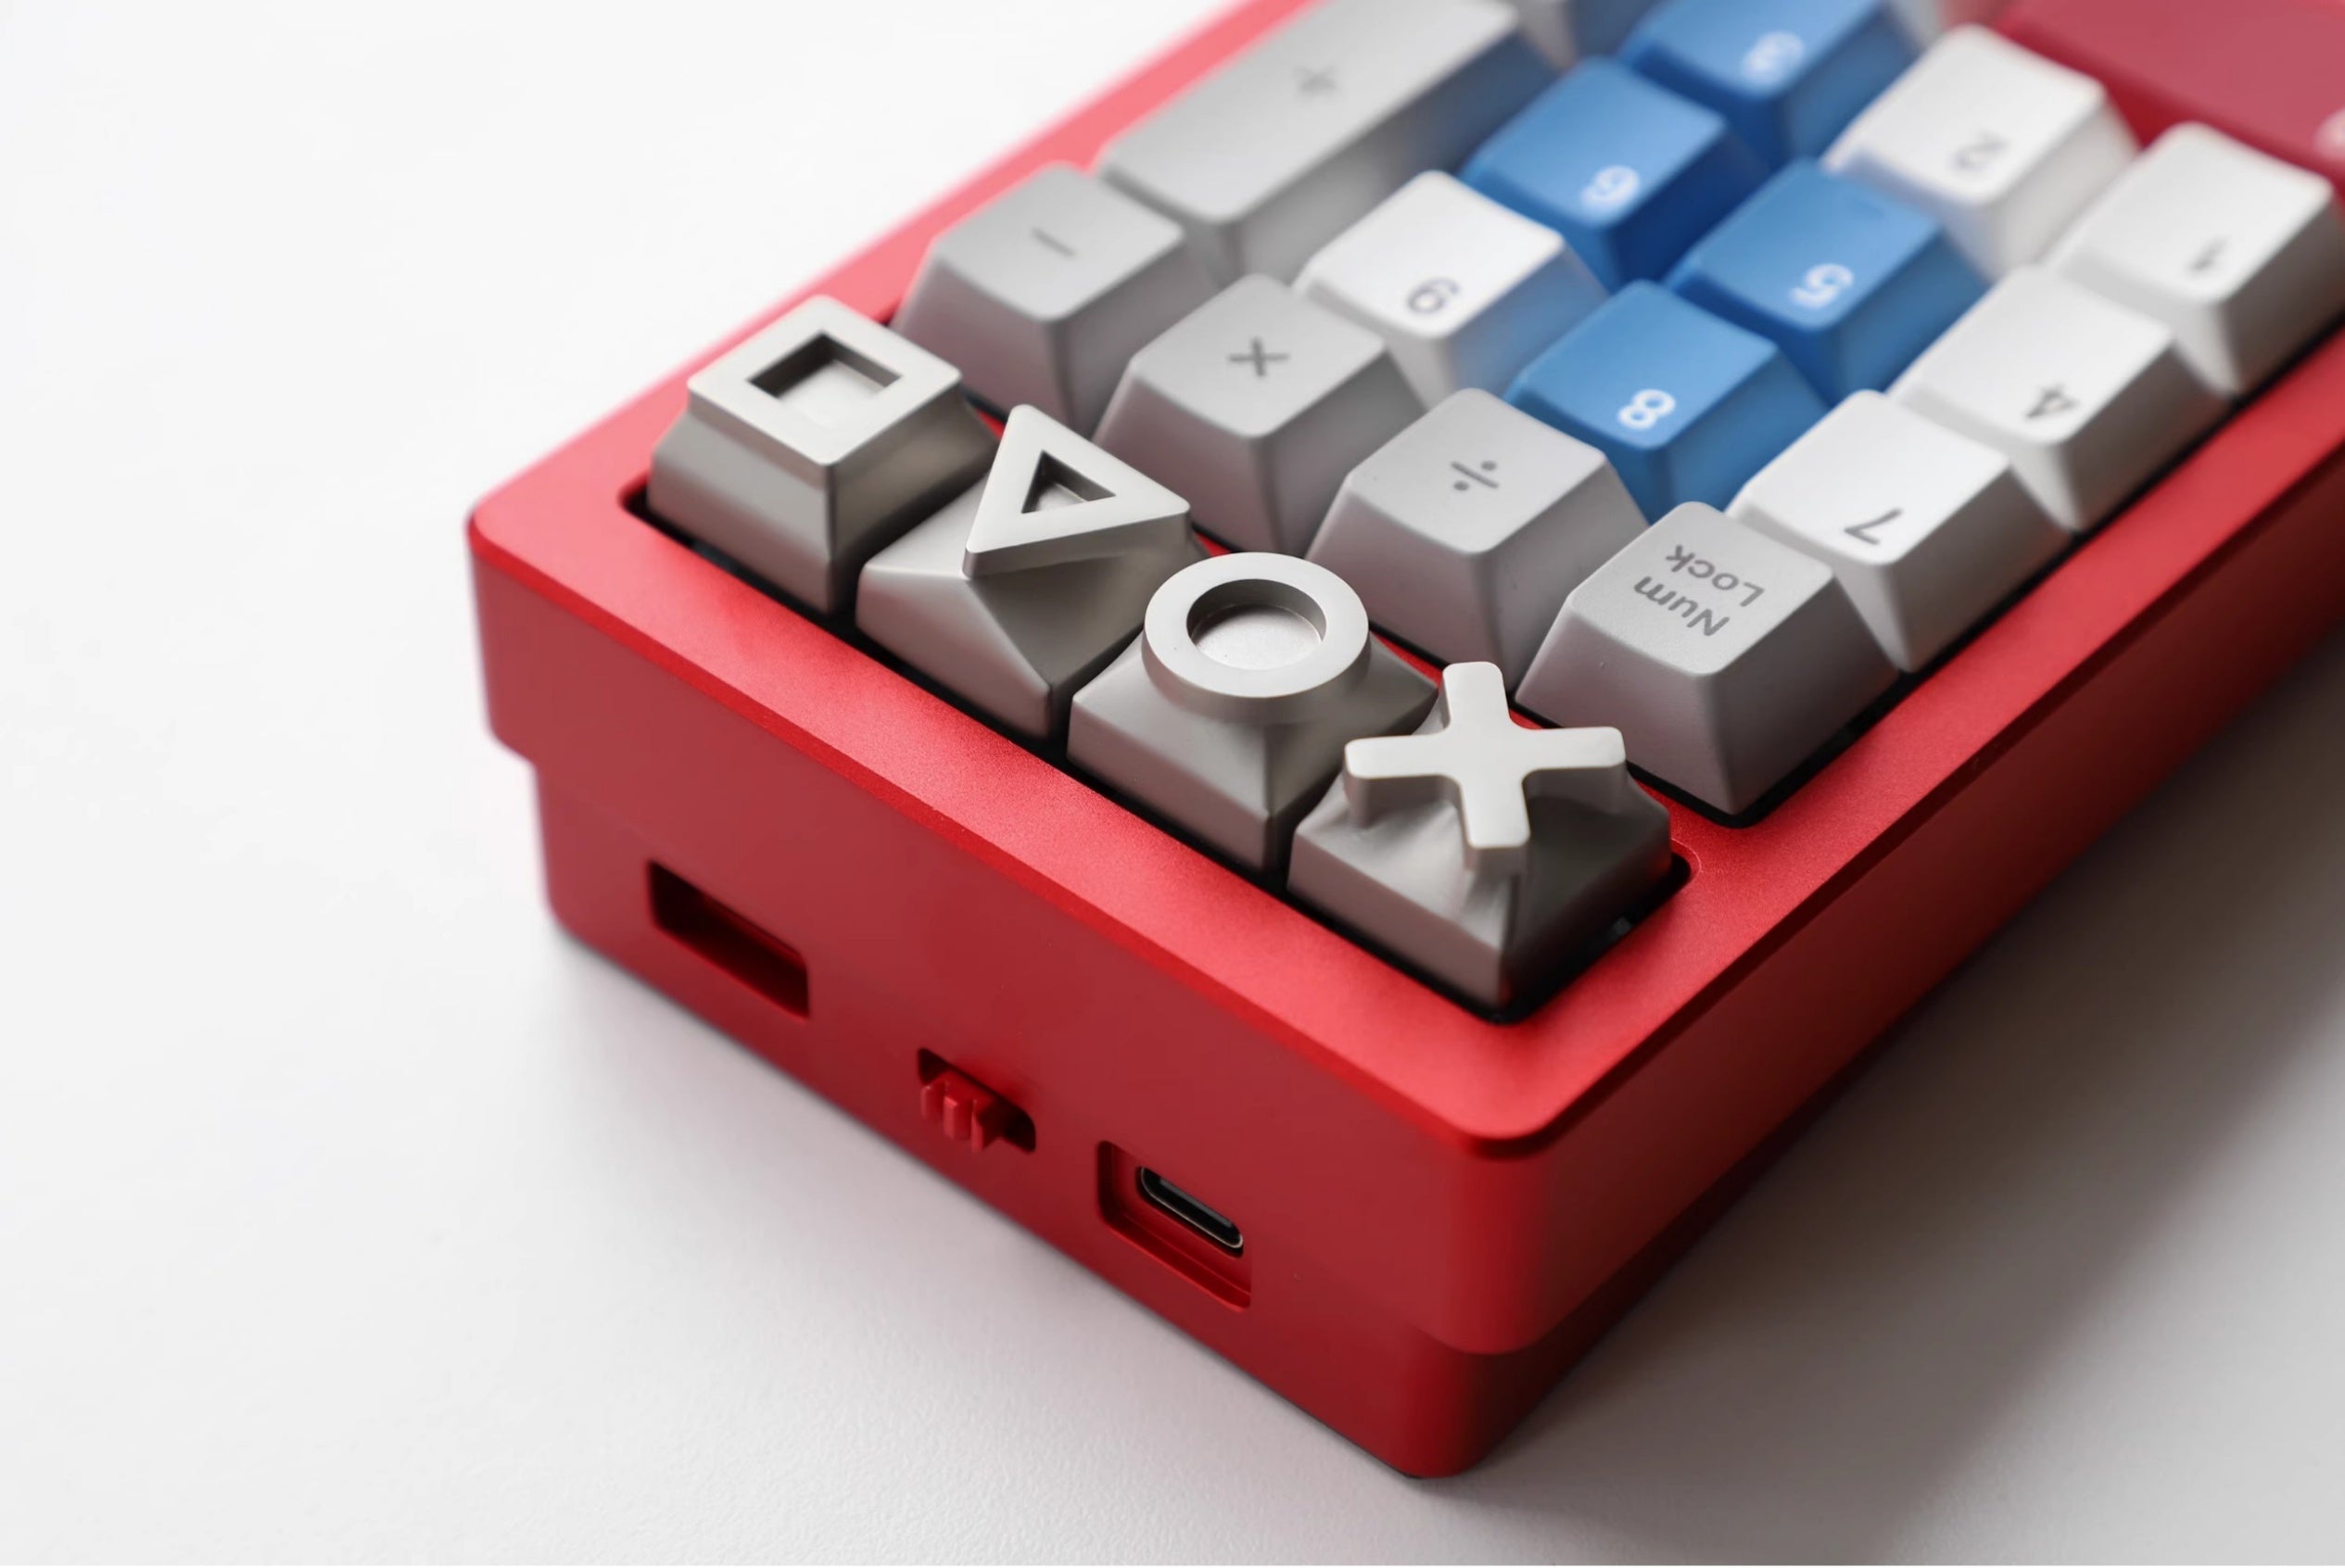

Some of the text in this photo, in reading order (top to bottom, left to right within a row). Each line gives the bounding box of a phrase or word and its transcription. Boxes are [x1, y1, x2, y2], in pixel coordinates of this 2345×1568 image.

[1580, 165, 1640, 209] 6
[1405, 279, 1460, 315] 9
[1789, 263, 1854, 309] 5
[1616, 389, 1676, 429] 8
[2026, 383, 2081, 421] 4
[1844, 507, 1905, 546] 7
[1666, 544, 1766, 607] Lock
[1633, 575, 1730, 637] Num
